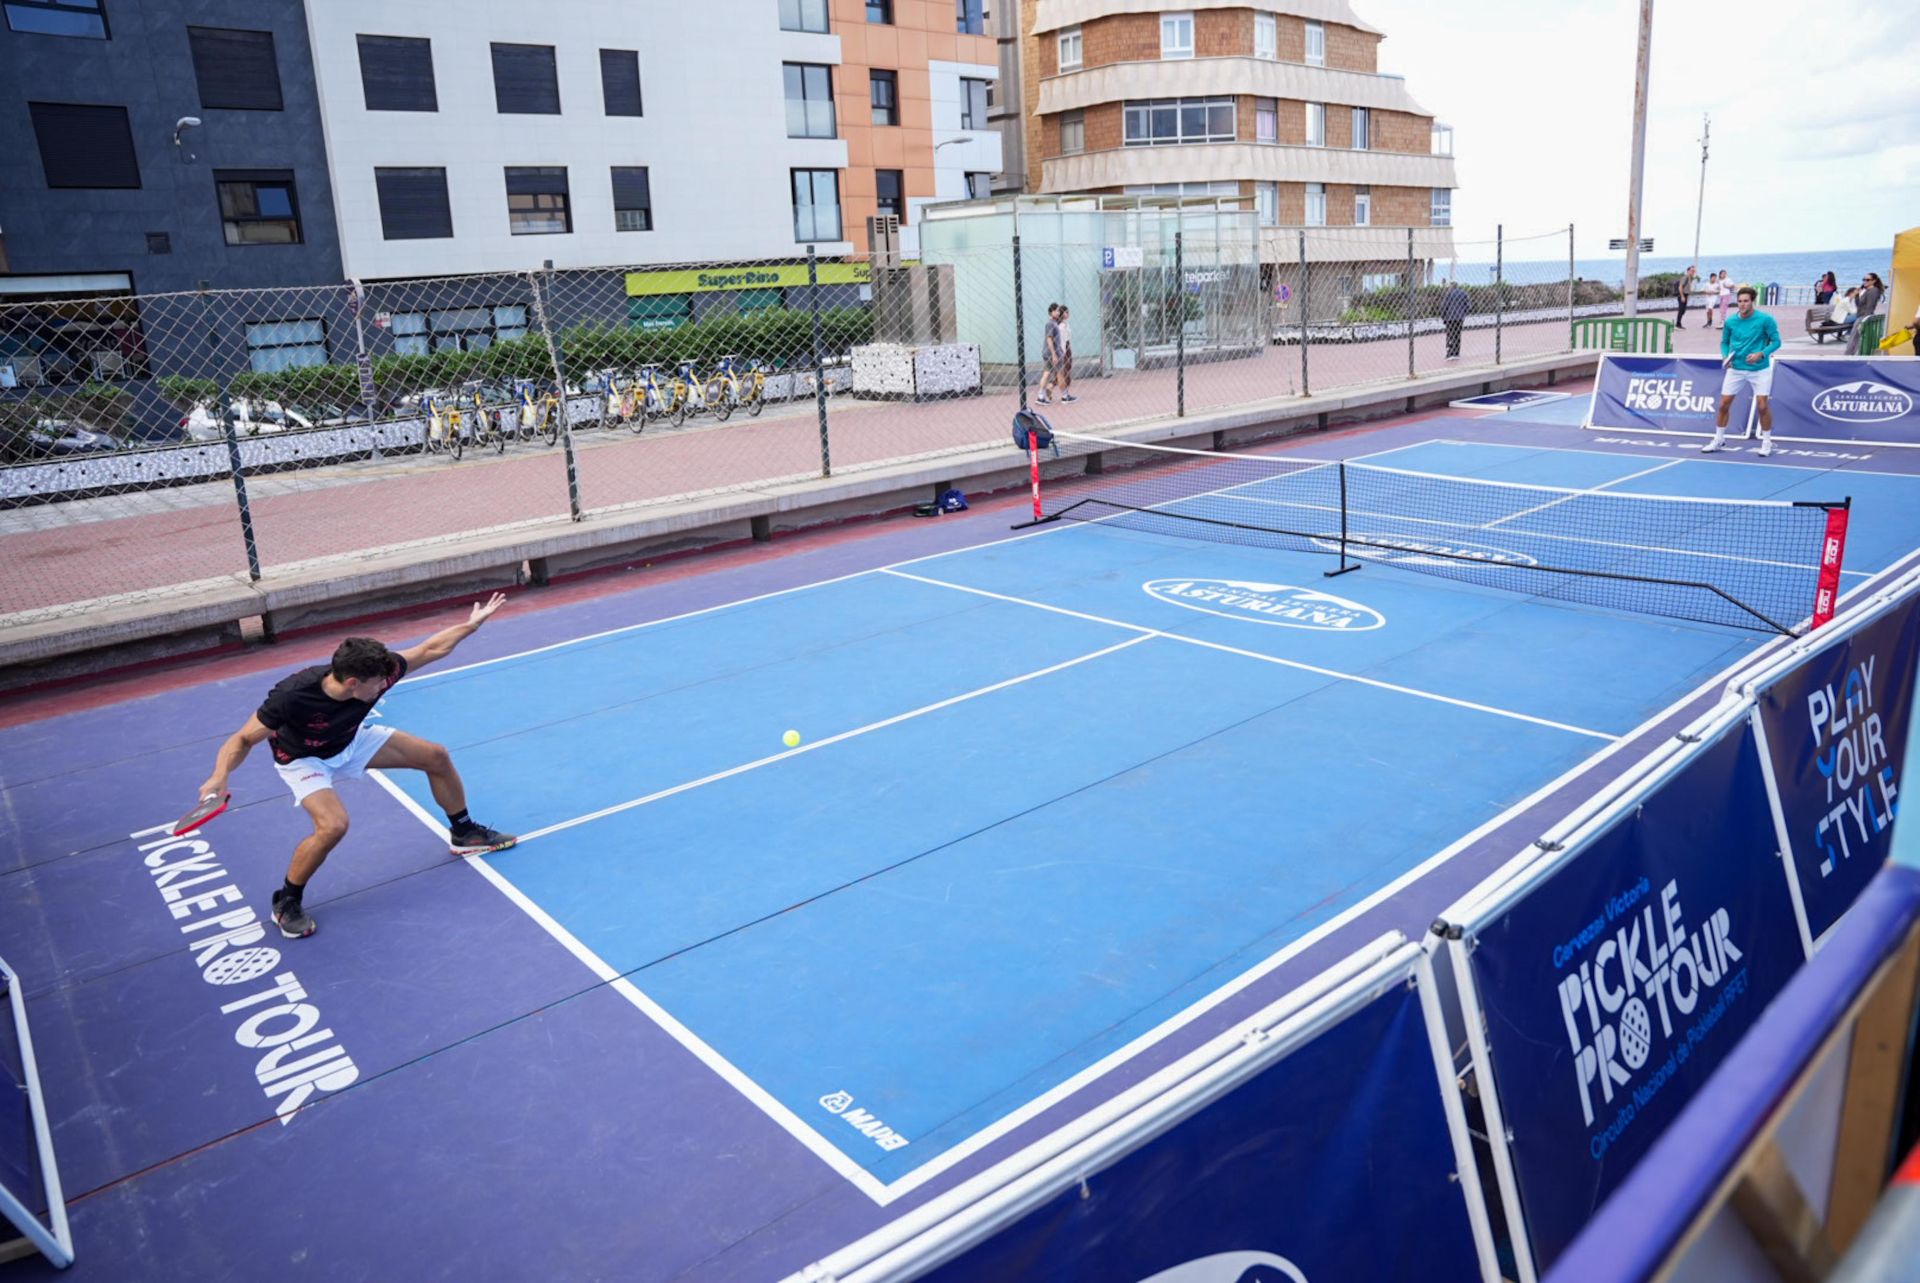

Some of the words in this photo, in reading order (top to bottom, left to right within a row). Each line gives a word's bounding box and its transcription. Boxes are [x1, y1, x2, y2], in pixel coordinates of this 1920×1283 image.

[697, 271, 779, 288] SuperDino
[1624, 393, 1662, 409] PRO
[1663, 395, 1716, 412] TOUR
[1628, 378, 1693, 396] PICKLE
[1819, 395, 1903, 413] ASTURIANA
[1152, 582, 1358, 628] ASTURIANA
[1207, 586, 1279, 602] CENTRAL
[1807, 654, 1875, 747] PLAY
[1816, 712, 1887, 803] YOUR
[1815, 766, 1899, 878] STYLE
[180, 905, 281, 985] PRO
[1552, 911, 1606, 968] Cervezas
[1604, 876, 1650, 921] Victoria
[1558, 878, 1686, 1056] PICKLE
[220, 971, 359, 1126] TOUR
[1574, 997, 1651, 1128] PRO
[1645, 907, 1743, 1039] TOUR
[1590, 1103, 1635, 1160] Circuito
[1632, 1052, 1677, 1110] Nacional
[1676, 1042, 1690, 1065] de
[1686, 993, 1726, 1048] Pickleball
[840, 1107, 910, 1152] MAPEI
